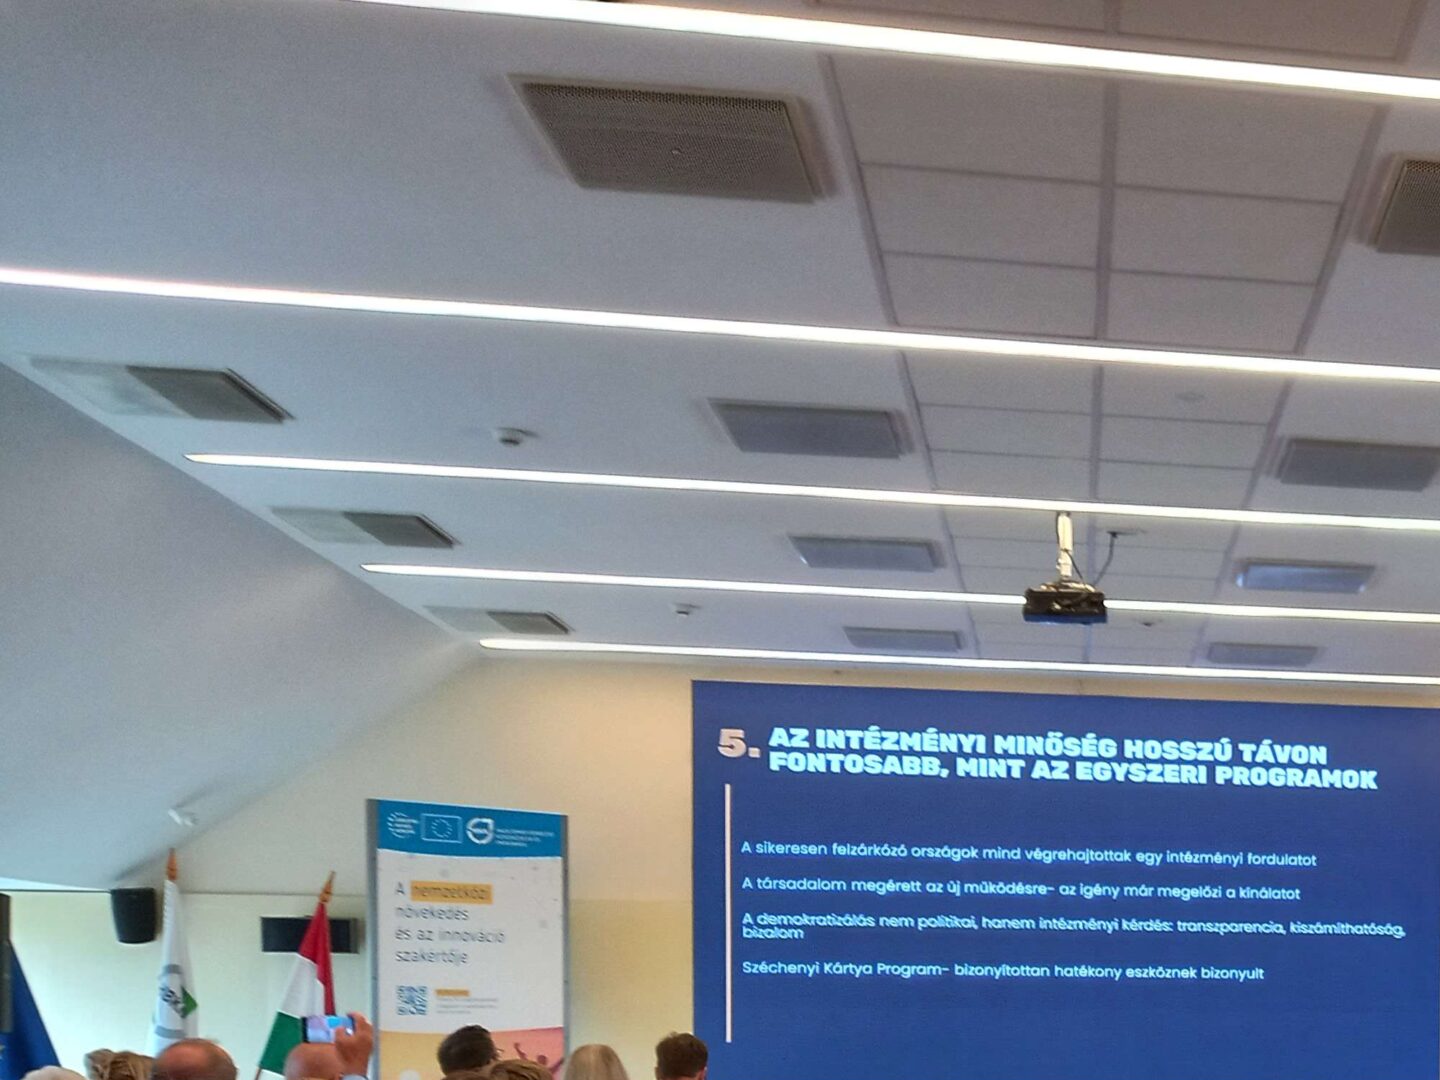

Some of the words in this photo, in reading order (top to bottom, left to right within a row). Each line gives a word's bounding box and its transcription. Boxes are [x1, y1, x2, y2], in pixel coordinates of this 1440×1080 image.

[717, 728, 760, 758] 5.
[769, 727, 809, 748] AZ
[815, 726, 985, 754] INTÉZMÉNYI
[994, 731, 1117, 758] MINŐSÉG
[1124, 738, 1232, 762] HOSSZÚ
[1238, 739, 1327, 764] TÁVON
[769, 752, 949, 777] FONTOSABB,
[956, 758, 1025, 778] MINT
[1031, 760, 1070, 780] AZ
[1075, 762, 1207, 784] EGYSZERI
[1215, 766, 1378, 790] PROGRAMOK
[741, 841, 751, 853] A
[756, 841, 827, 855] sikeresen
[832, 843, 907, 857] felzárkózó
[912, 846, 978, 861] országok
[983, 847, 1020, 859] mind
[1025, 847, 1131, 863] végrehajtottak
[1136, 852, 1162, 866] egy
[1167, 850, 1243, 867] intézményi
[1248, 852, 1317, 866] fordulatot
[396, 882, 405, 895] A
[742, 877, 753, 889] A
[757, 877, 846, 891] társadalom
[852, 880, 921, 895] megérett
[926, 882, 943, 893] az
[947, 880, 960, 896] új
[964, 880, 1054, 895] működésre-
[1059, 885, 1076, 895] az
[1080, 883, 1119, 899] igény
[1124, 884, 1153, 897] már
[1158, 885, 1221, 901] megelőzi
[1226, 889, 1235, 898] a
[1239, 887, 1300, 900] kínálatot
[396, 926, 411, 941] és
[417, 929, 433, 942] az
[742, 913, 753, 925] A
[757, 912, 875, 927] demokratizálás
[879, 916, 914, 927] nem
[918, 915, 978, 931] politikai,
[982, 916, 1035, 929] hanem
[1040, 917, 1119, 934] intézményi
[1122, 918, 1173, 931] kérdés:
[1177, 920, 1286, 936] transzparencia,
[743, 925, 804, 939] bizalom
[742, 962, 819, 977] Széchenyi
[824, 962, 873, 978] Kártya
[877, 963, 949, 978] Program-
[955, 963, 1050, 980] bizonyítottan
[1055, 965, 1121, 981] hatékony
[1126, 966, 1197, 980] eszköznek
[1202, 966, 1264, 982] bizonyult
